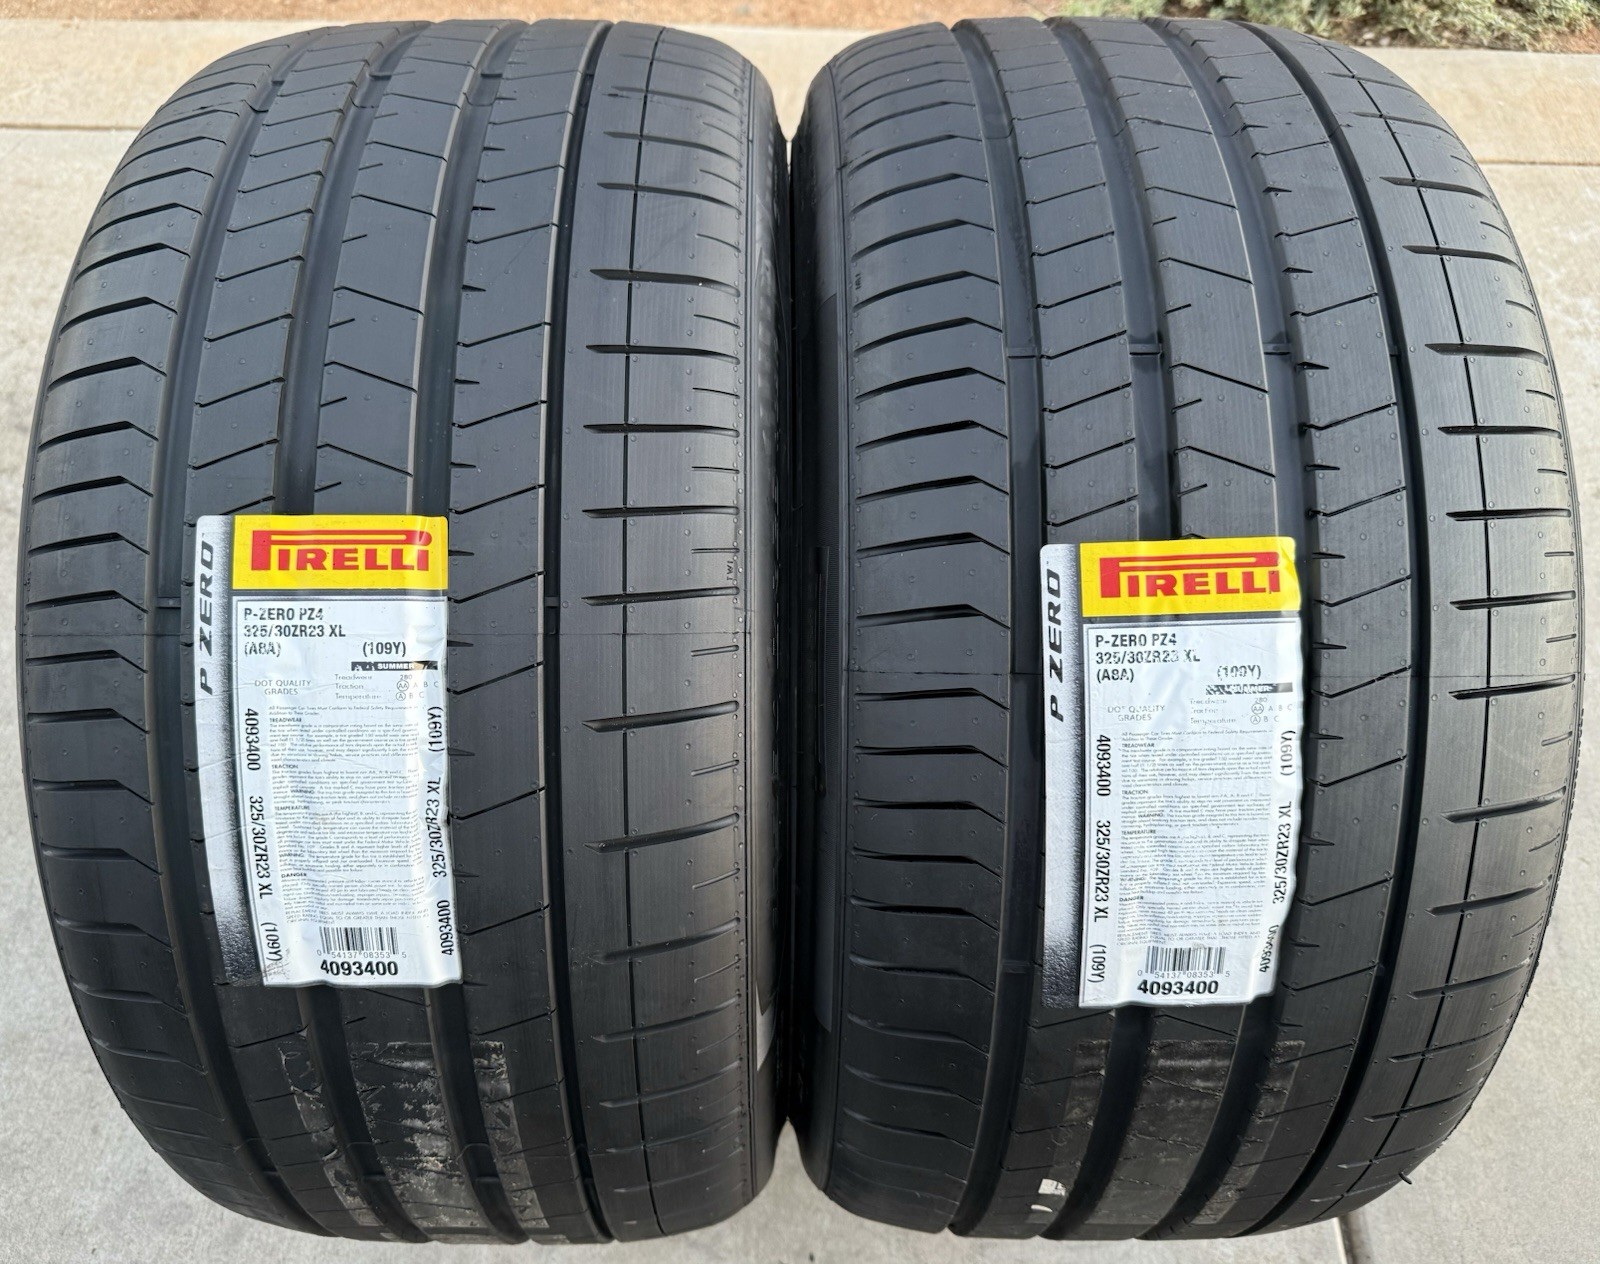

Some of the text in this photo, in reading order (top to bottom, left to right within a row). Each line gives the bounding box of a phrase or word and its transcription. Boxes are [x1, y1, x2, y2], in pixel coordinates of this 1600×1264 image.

[251, 529, 433, 571] PIRELLI
[1100, 552, 1281, 599] PIRELLI
[199, 540, 214, 695] P ZERO
[244, 607, 324, 621] P-ZERO PZ4
[244, 624, 346, 638] 325/30ZR23 XL
[1047, 568, 1064, 722] P ZERO
[1096, 632, 1177, 648] P-ZERO PZ4
[362, 641, 407, 657] (109Y)
[1096, 648, 1201, 665] 325/30ZR23 XL
[377, 662, 415, 670] SUMMER
[275, 679, 312, 688] QUALITY
[264, 688, 299, 696] GRADES
[1118, 713, 1152, 722] GRADES
[1280, 730, 1296, 776] (109Y)
[1279, 800, 1293, 818] XL
[244, 708, 282, 963] 4093400 325/30ZR23 XL (109Y)
[425, 706, 455, 957] 4093400 325/30ZR23 XL (109Y)
[1087, 734, 1112, 984] 4093400 325/30ZR23 XL (109Y)
[1272, 822, 1292, 905] 325/30ZR23
[316, 949, 407, 959] 0 54137 08353 5
[320, 960, 400, 976] 4093400
[1154, 970, 1181, 979] 54137
[1186, 970, 1214, 978] 08353
[1224, 970, 1231, 978] 5
[1136, 980, 1220, 996] 4093400
